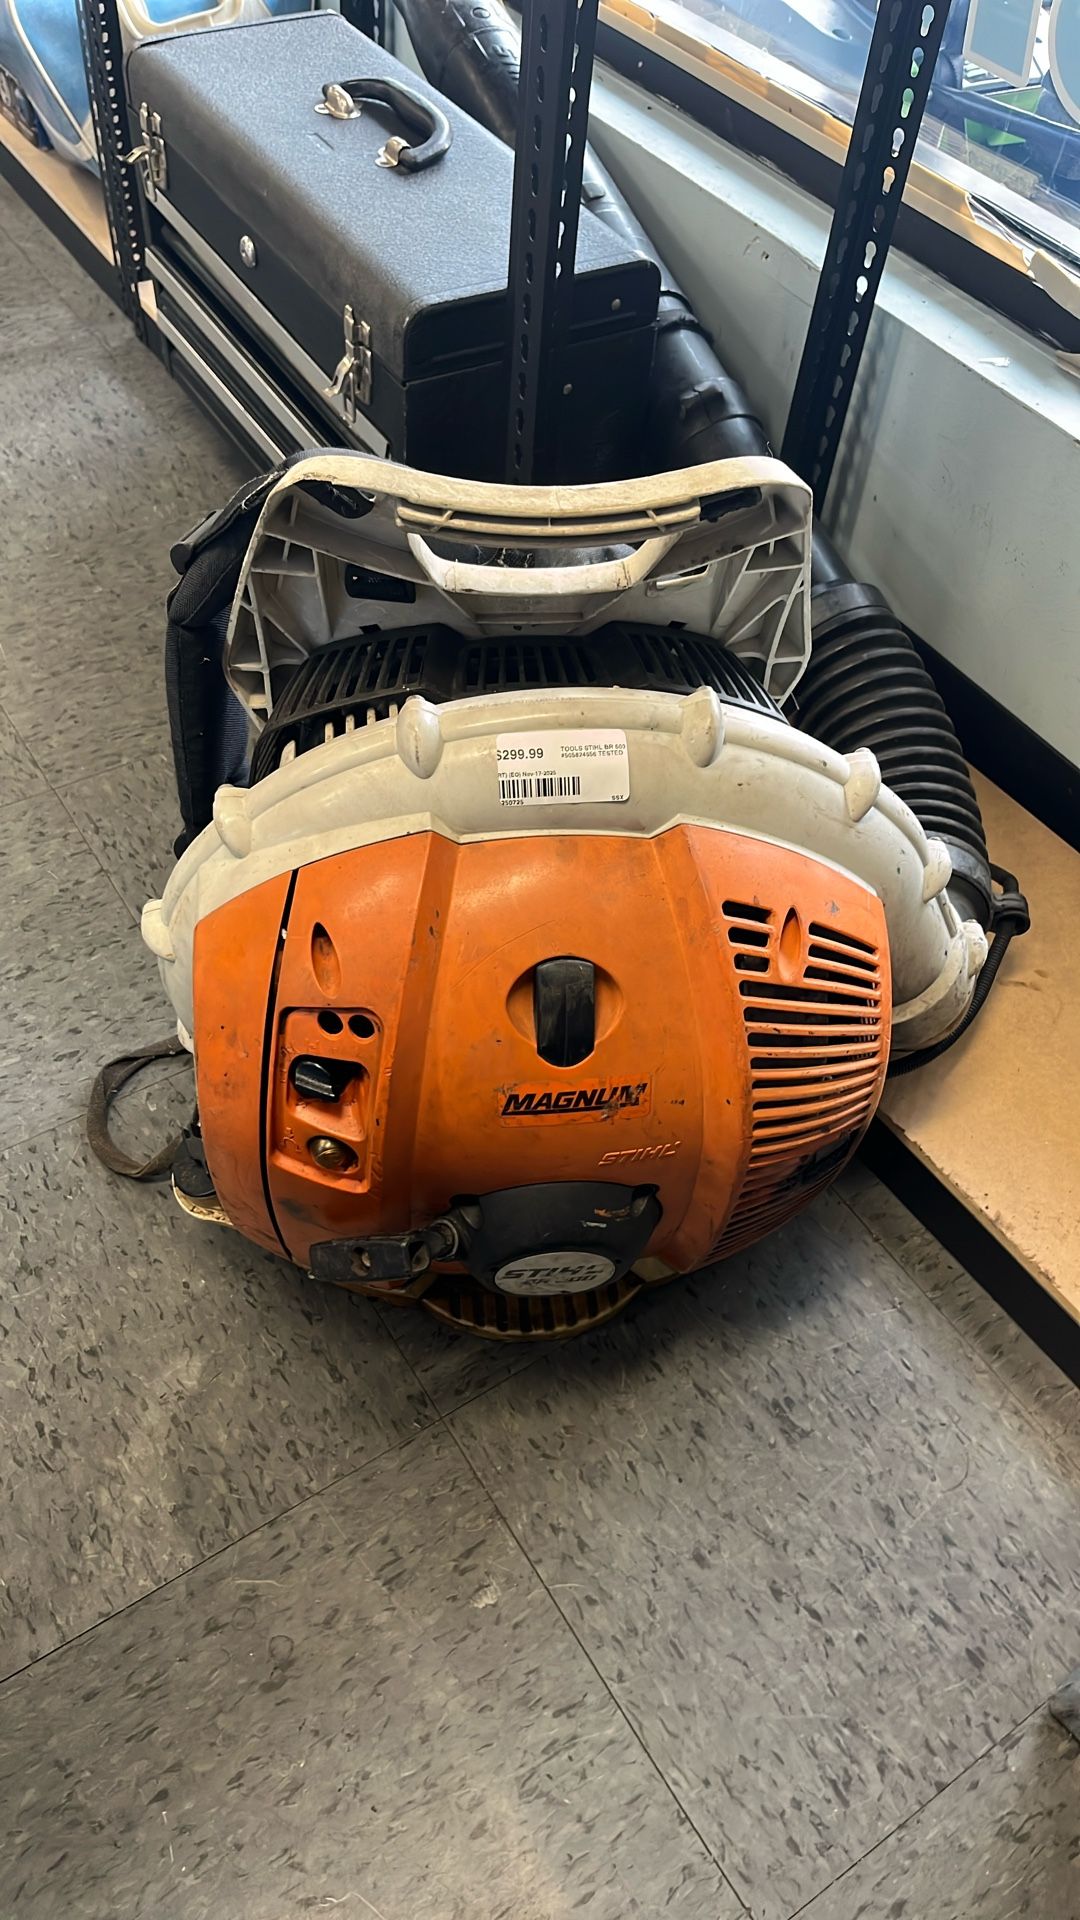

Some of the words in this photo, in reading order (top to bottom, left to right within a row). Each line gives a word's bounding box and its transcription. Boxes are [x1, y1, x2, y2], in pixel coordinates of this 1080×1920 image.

[497, 748, 544, 760] $299.99
[502, 1083, 648, 1114] MAGNUM
[598, 1140, 681, 1167] STIHL
[502, 1263, 604, 1280] STIHL
